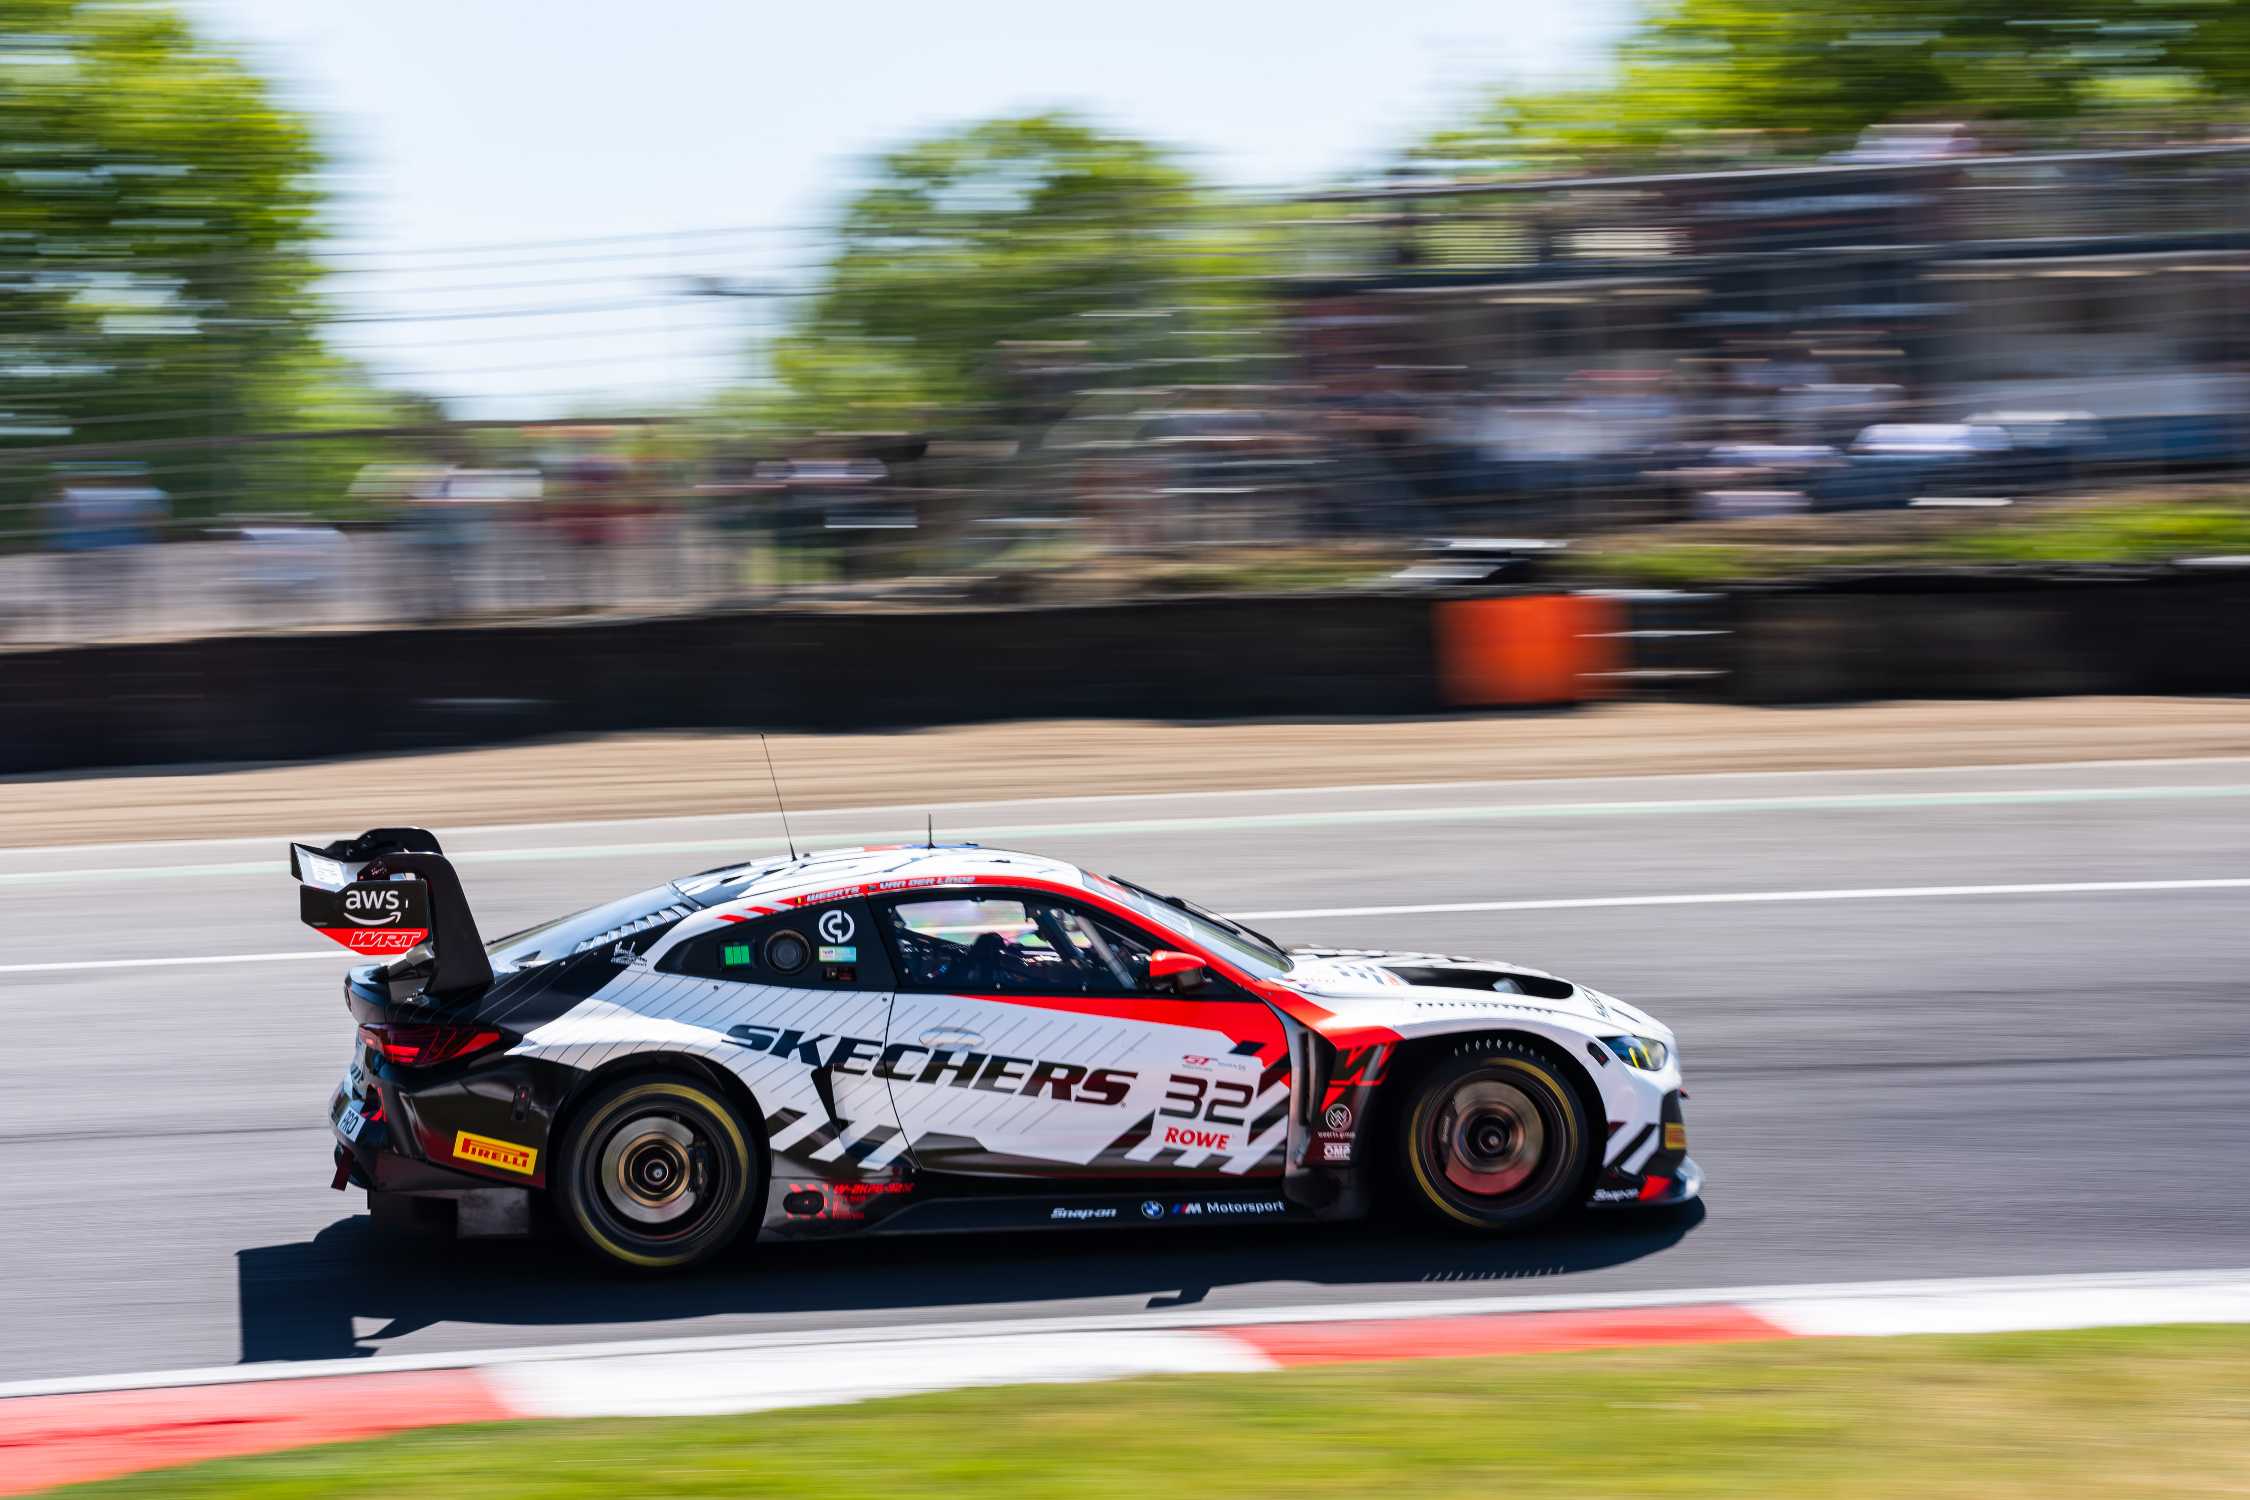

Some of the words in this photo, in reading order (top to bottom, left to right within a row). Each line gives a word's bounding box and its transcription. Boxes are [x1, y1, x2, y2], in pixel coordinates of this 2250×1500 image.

[345, 889, 400, 910] aws
[350, 931, 422, 948] WRT
[721, 1024, 1138, 1106] SKECHERS
[1159, 1073, 1254, 1127] 32
[339, 1109, 360, 1135] PRO
[1164, 1126, 1230, 1151] ROWE
[461, 1137, 530, 1168] PIRELLI
[1206, 1200, 1285, 1215] Motorsport
